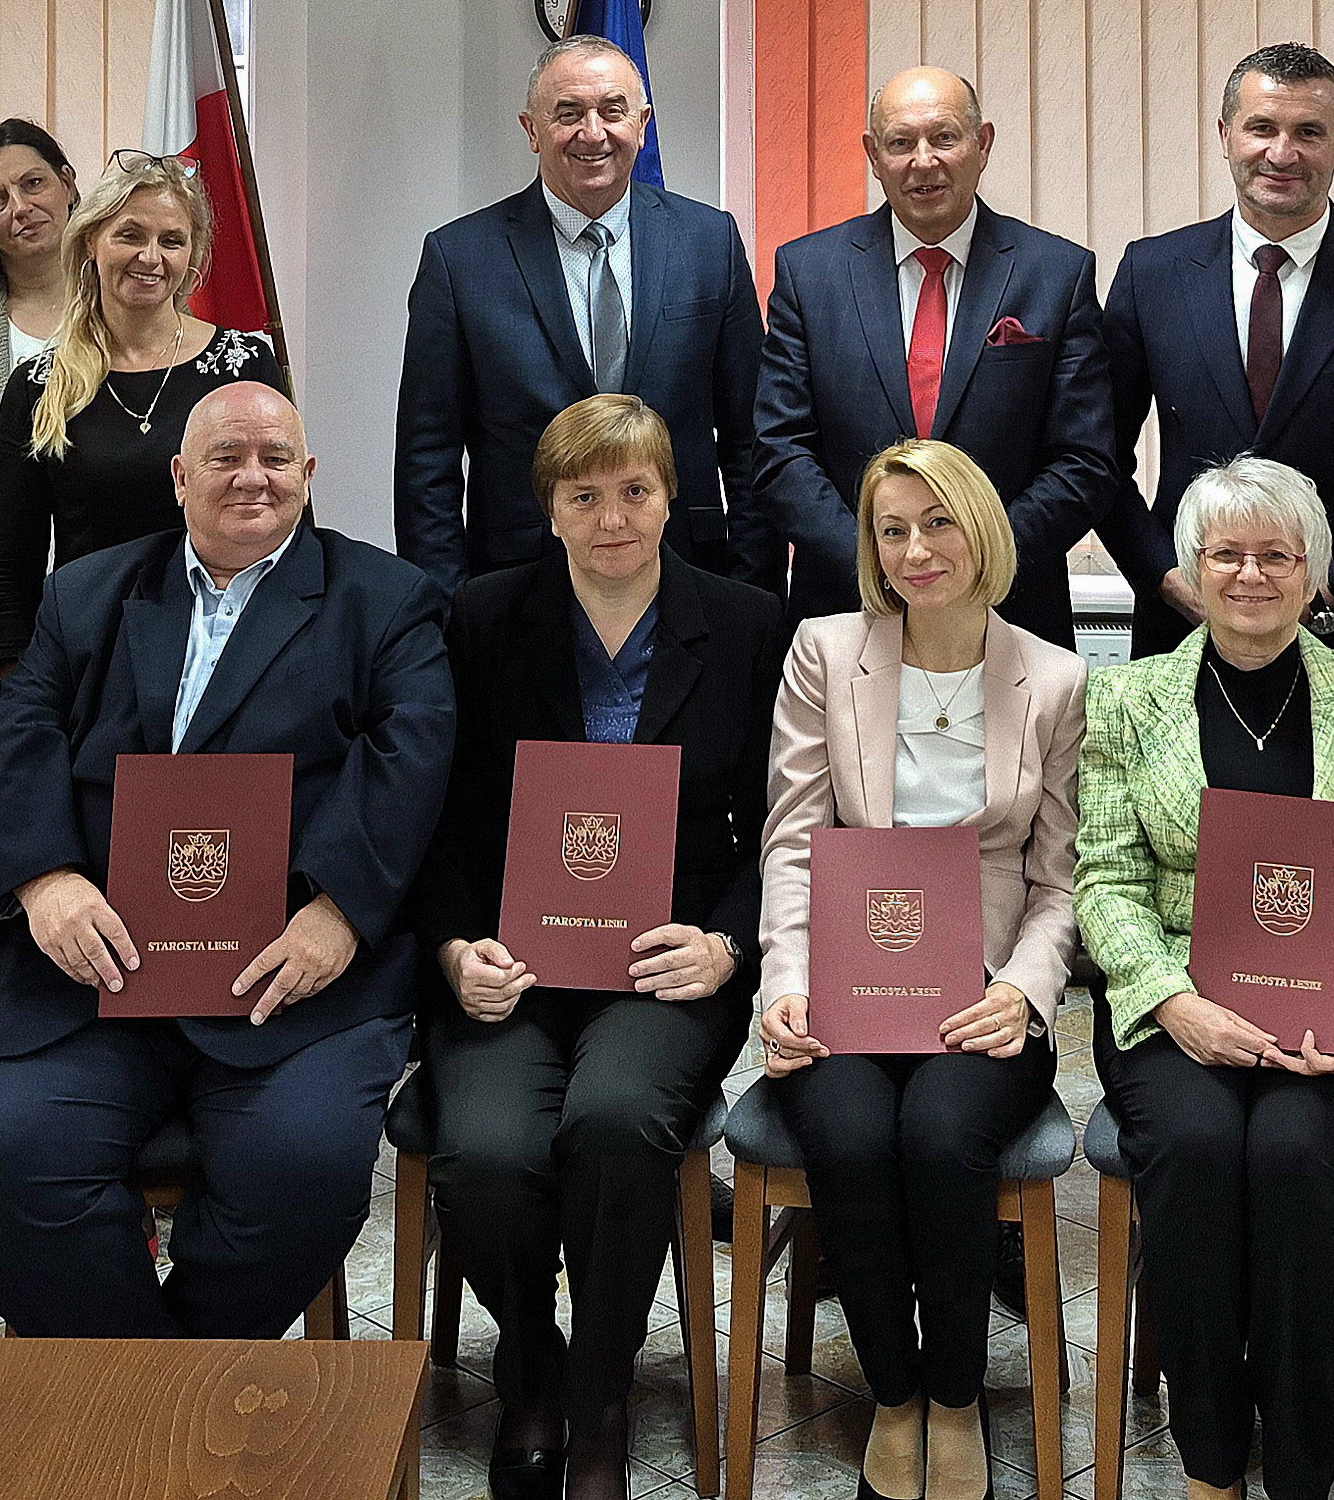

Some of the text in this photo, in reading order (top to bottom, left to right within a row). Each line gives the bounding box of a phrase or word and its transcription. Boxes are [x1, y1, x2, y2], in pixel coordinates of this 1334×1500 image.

[557, 15, 565, 27] 8
[541, 915, 596, 928] STAROSTA
[147, 941, 205, 952] STAROSTA
[1231, 972, 1288, 988] STAROSTA
[851, 986, 908, 996] STAROSTA
